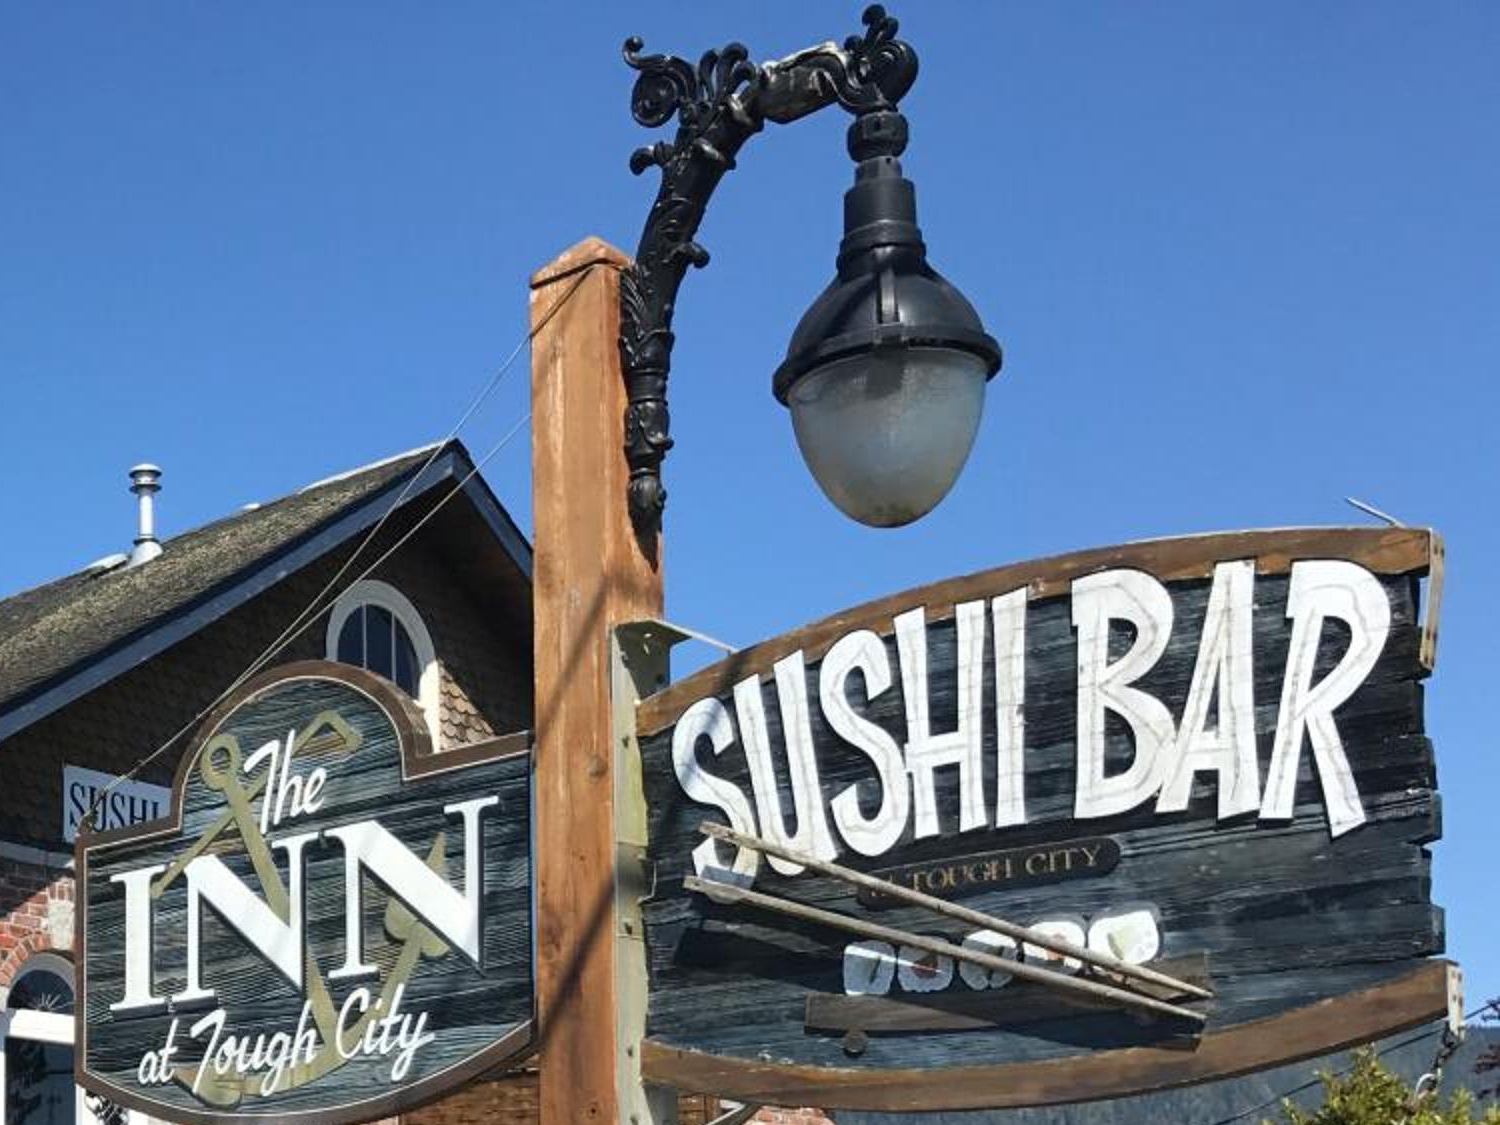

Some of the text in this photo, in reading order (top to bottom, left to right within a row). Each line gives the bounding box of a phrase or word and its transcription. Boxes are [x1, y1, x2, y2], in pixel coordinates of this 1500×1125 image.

[243, 729, 327, 834] The
[672, 559, 1392, 902] SUSHI BAR
[69, 781, 160, 832] SUSHI
[109, 795, 499, 1012] INN
[906, 858, 1012, 892] TOUGH
[1025, 843, 1102, 876] CITY
[137, 983, 436, 1097] at Tough City
